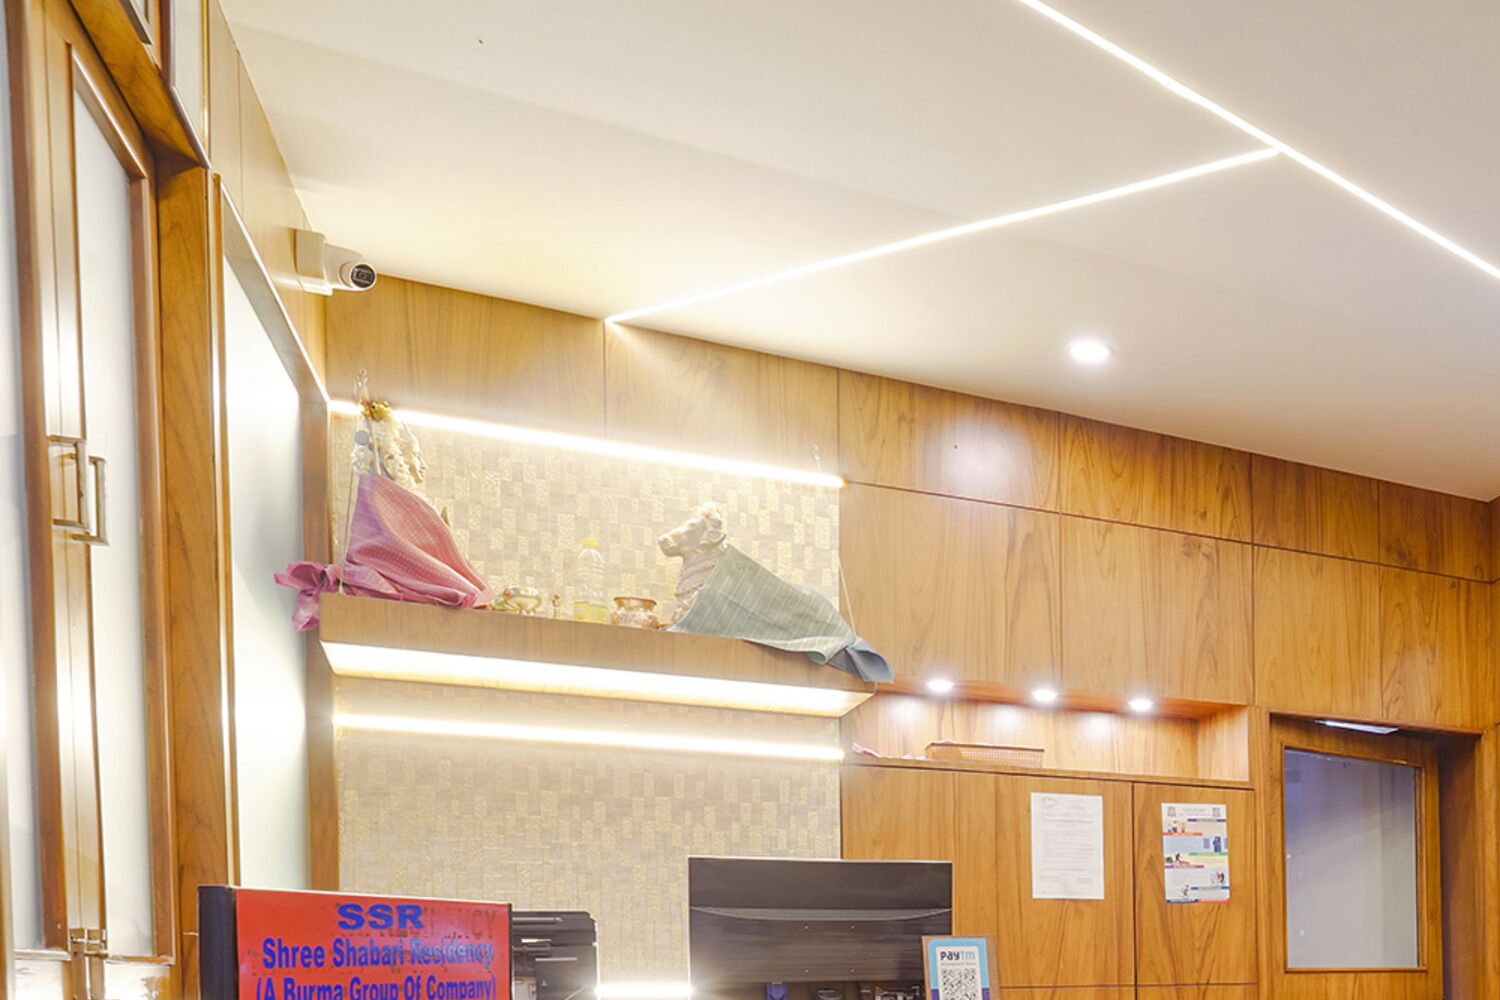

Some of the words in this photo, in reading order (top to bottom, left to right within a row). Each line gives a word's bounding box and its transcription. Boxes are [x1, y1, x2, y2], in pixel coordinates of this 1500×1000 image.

[337, 903, 424, 930] SSR
[262, 937, 326, 969] Shree
[332, 938, 405, 968] Shabari
[411, 938, 494, 969] Residency
